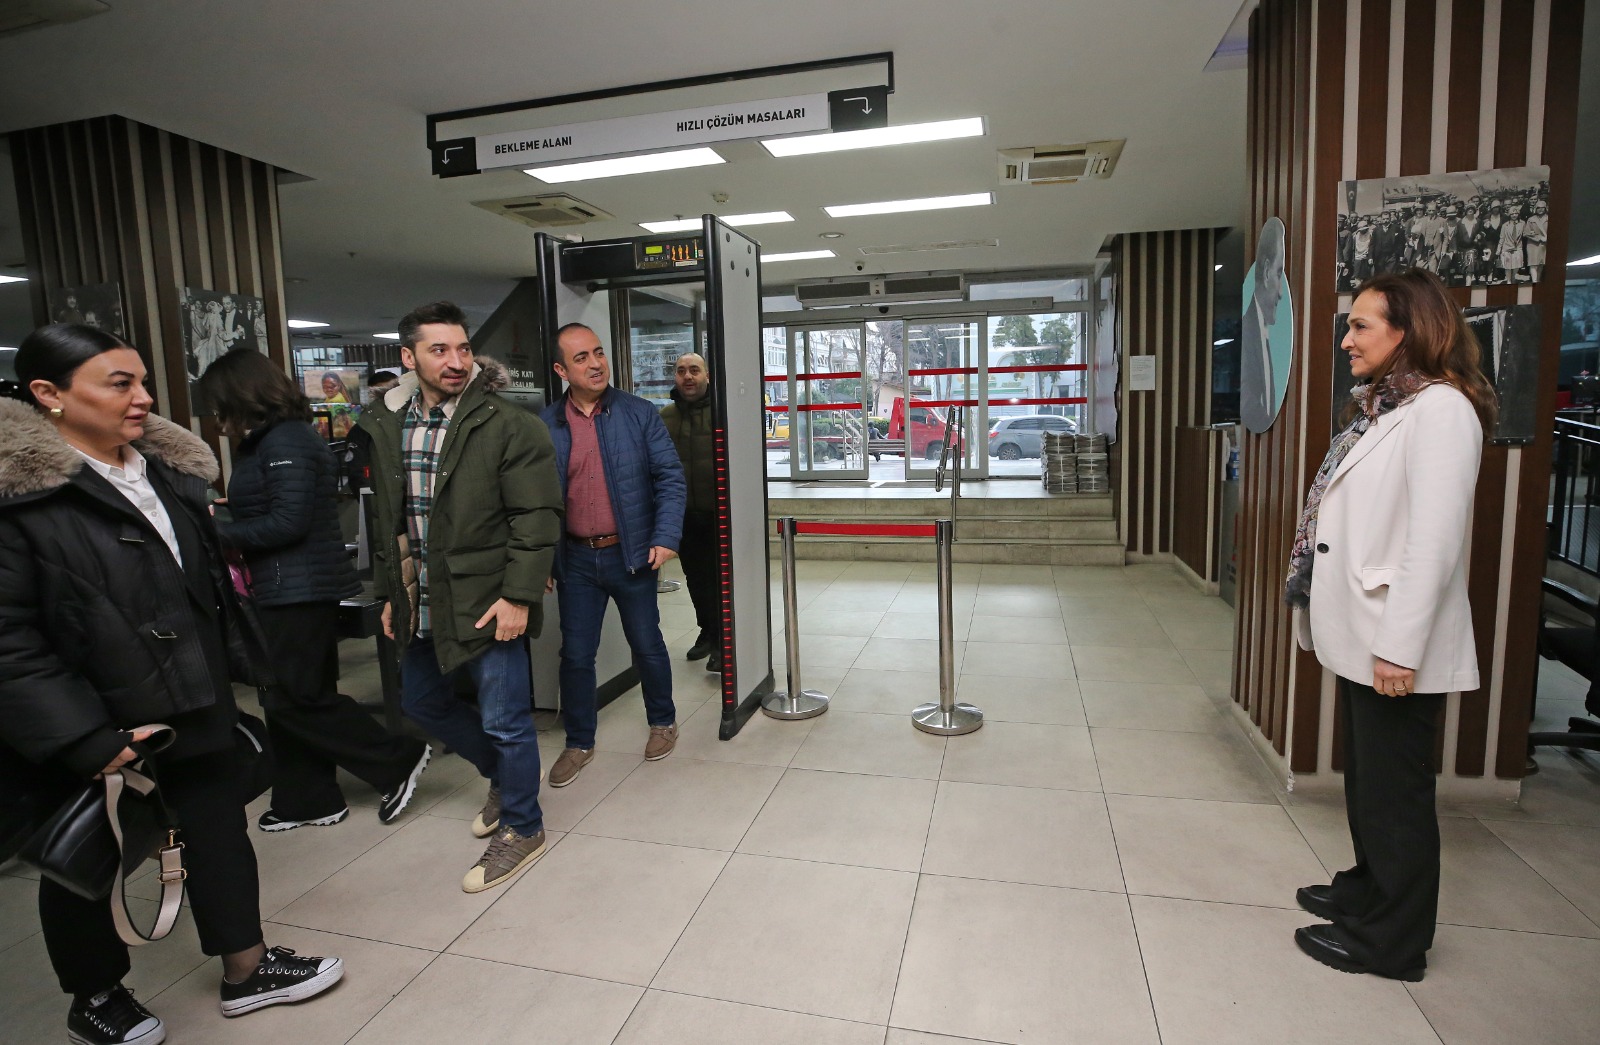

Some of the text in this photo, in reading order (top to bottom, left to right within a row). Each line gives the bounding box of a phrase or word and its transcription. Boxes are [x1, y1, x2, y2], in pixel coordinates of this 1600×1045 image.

[676, 107, 806, 132] HIZLI ÇÖZÜM MASALARI
[494, 136, 572, 154] BEKLEME ALANI
[521, 370, 534, 378] KATI
